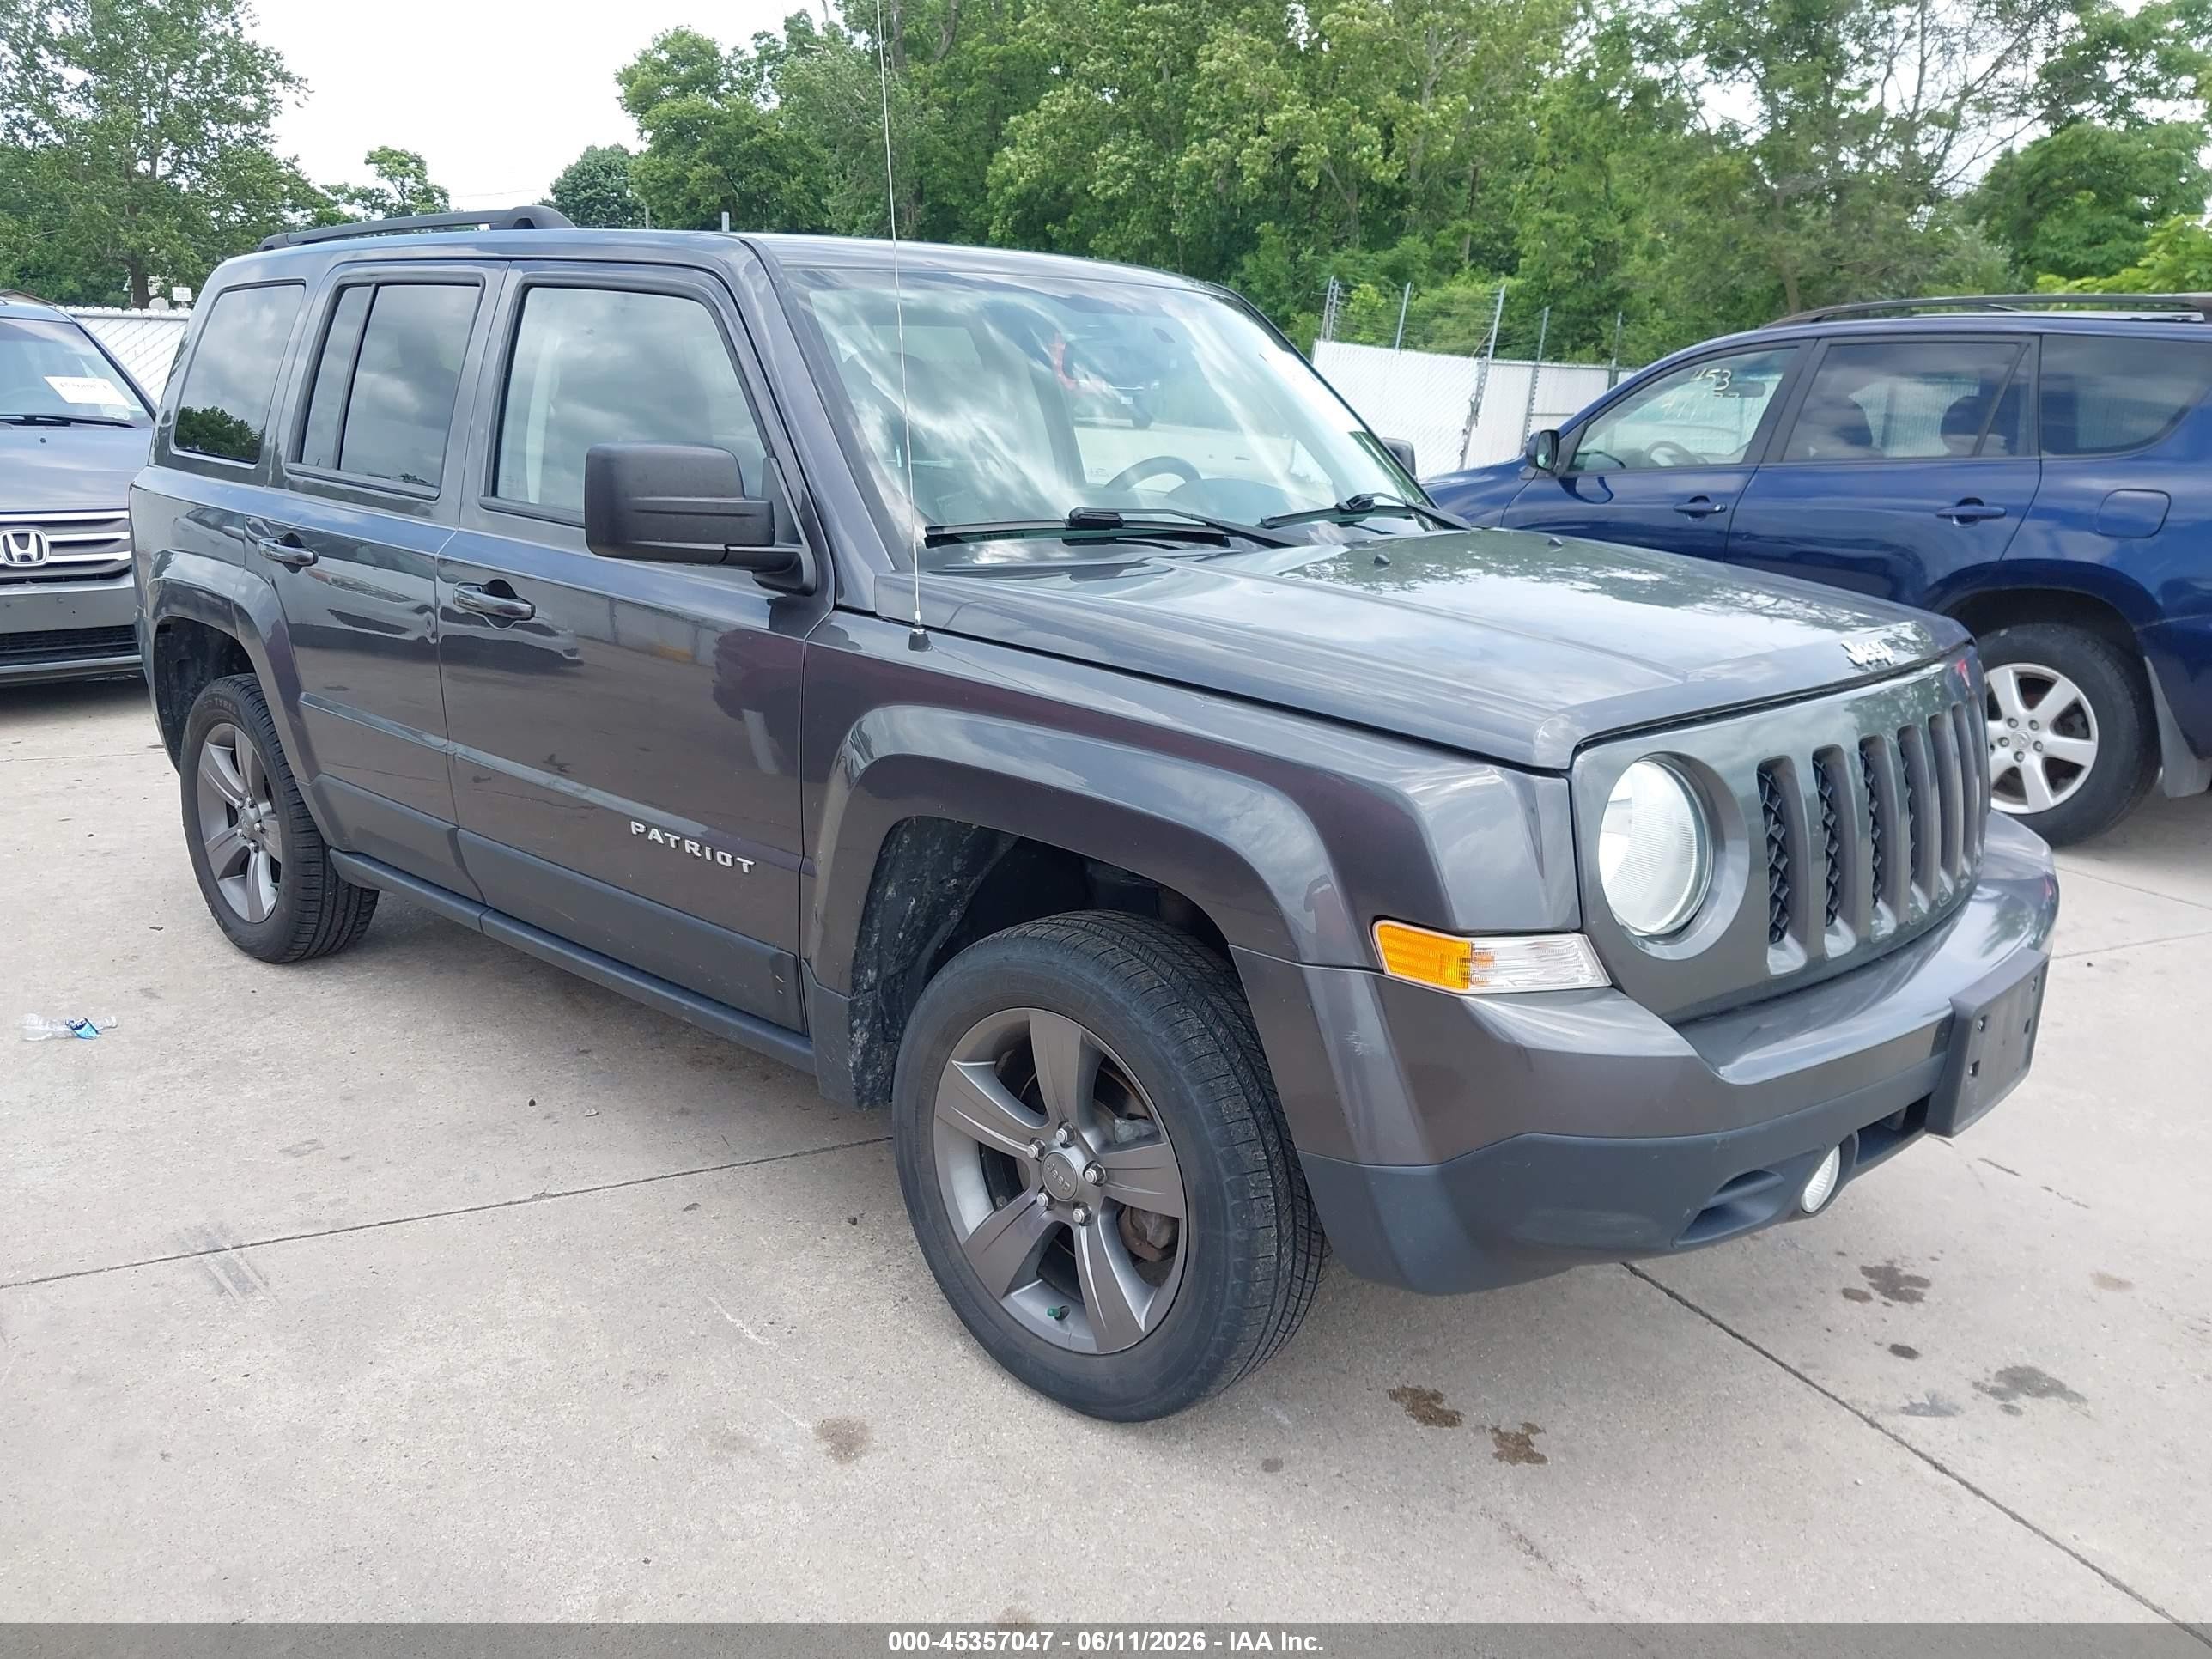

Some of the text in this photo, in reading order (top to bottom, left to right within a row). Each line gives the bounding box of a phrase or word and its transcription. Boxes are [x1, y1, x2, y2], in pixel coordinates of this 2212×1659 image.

[1689, 368, 1732, 391] 453
[1840, 639, 1894, 670] Jeep
[630, 821, 756, 874] PATRIOT
[1046, 1162, 1072, 1192] Jeep
